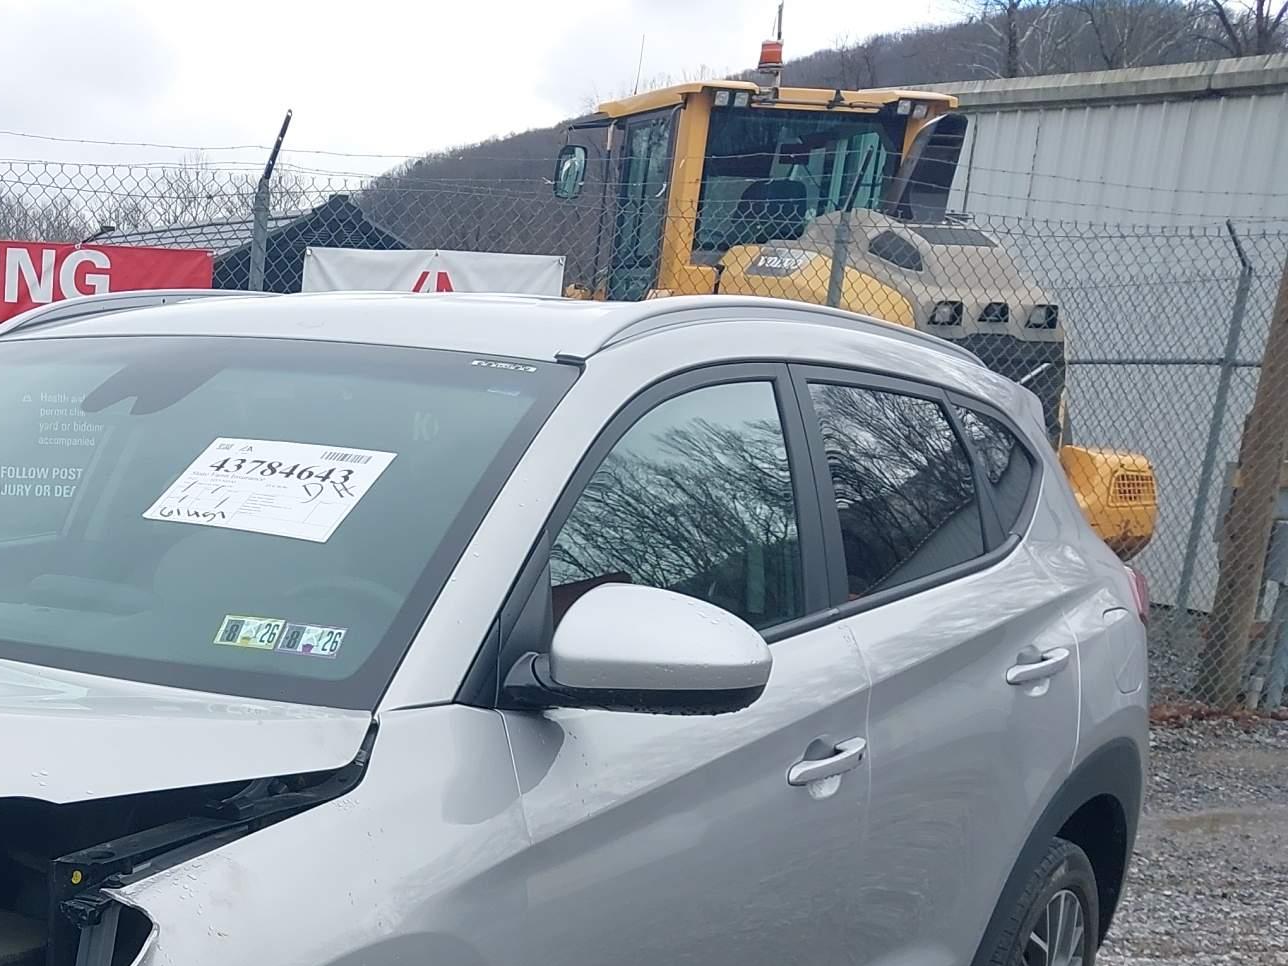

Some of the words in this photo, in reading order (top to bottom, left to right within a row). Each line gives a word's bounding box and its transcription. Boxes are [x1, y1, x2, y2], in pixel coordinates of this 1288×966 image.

[61, 423, 70, 432] or
[38, 435, 95, 447] accompanied
[1, 466, 48, 479] FOLLOW
[210, 457, 355, 484] 43784643
[35, 485, 50, 496] OR
[259, 623, 280, 644] 26
[321, 630, 342, 652] 26
